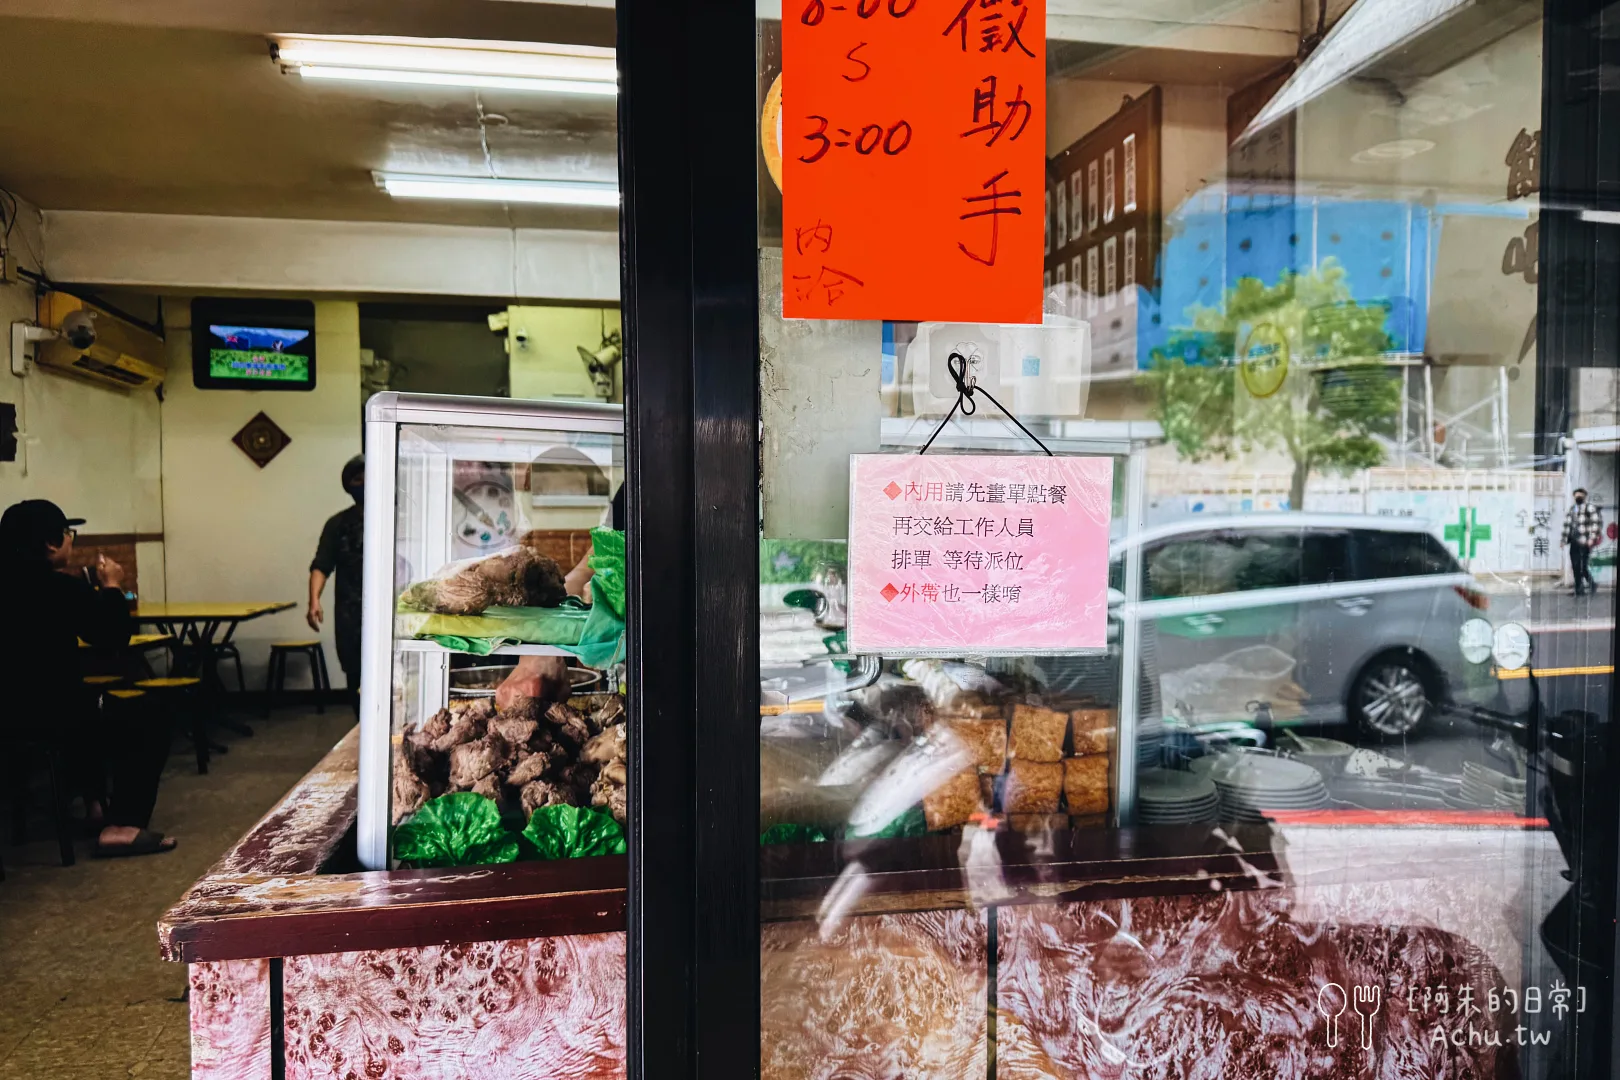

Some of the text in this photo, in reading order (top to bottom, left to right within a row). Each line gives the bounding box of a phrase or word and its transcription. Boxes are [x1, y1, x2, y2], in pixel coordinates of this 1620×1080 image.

[797, 115, 913, 164] 3:00
[904, 481, 1068, 505] 內用請先畫單點餐
[892, 515, 1035, 538] 再交給工作人員
[891, 549, 1024, 571] 排單 等待派位
